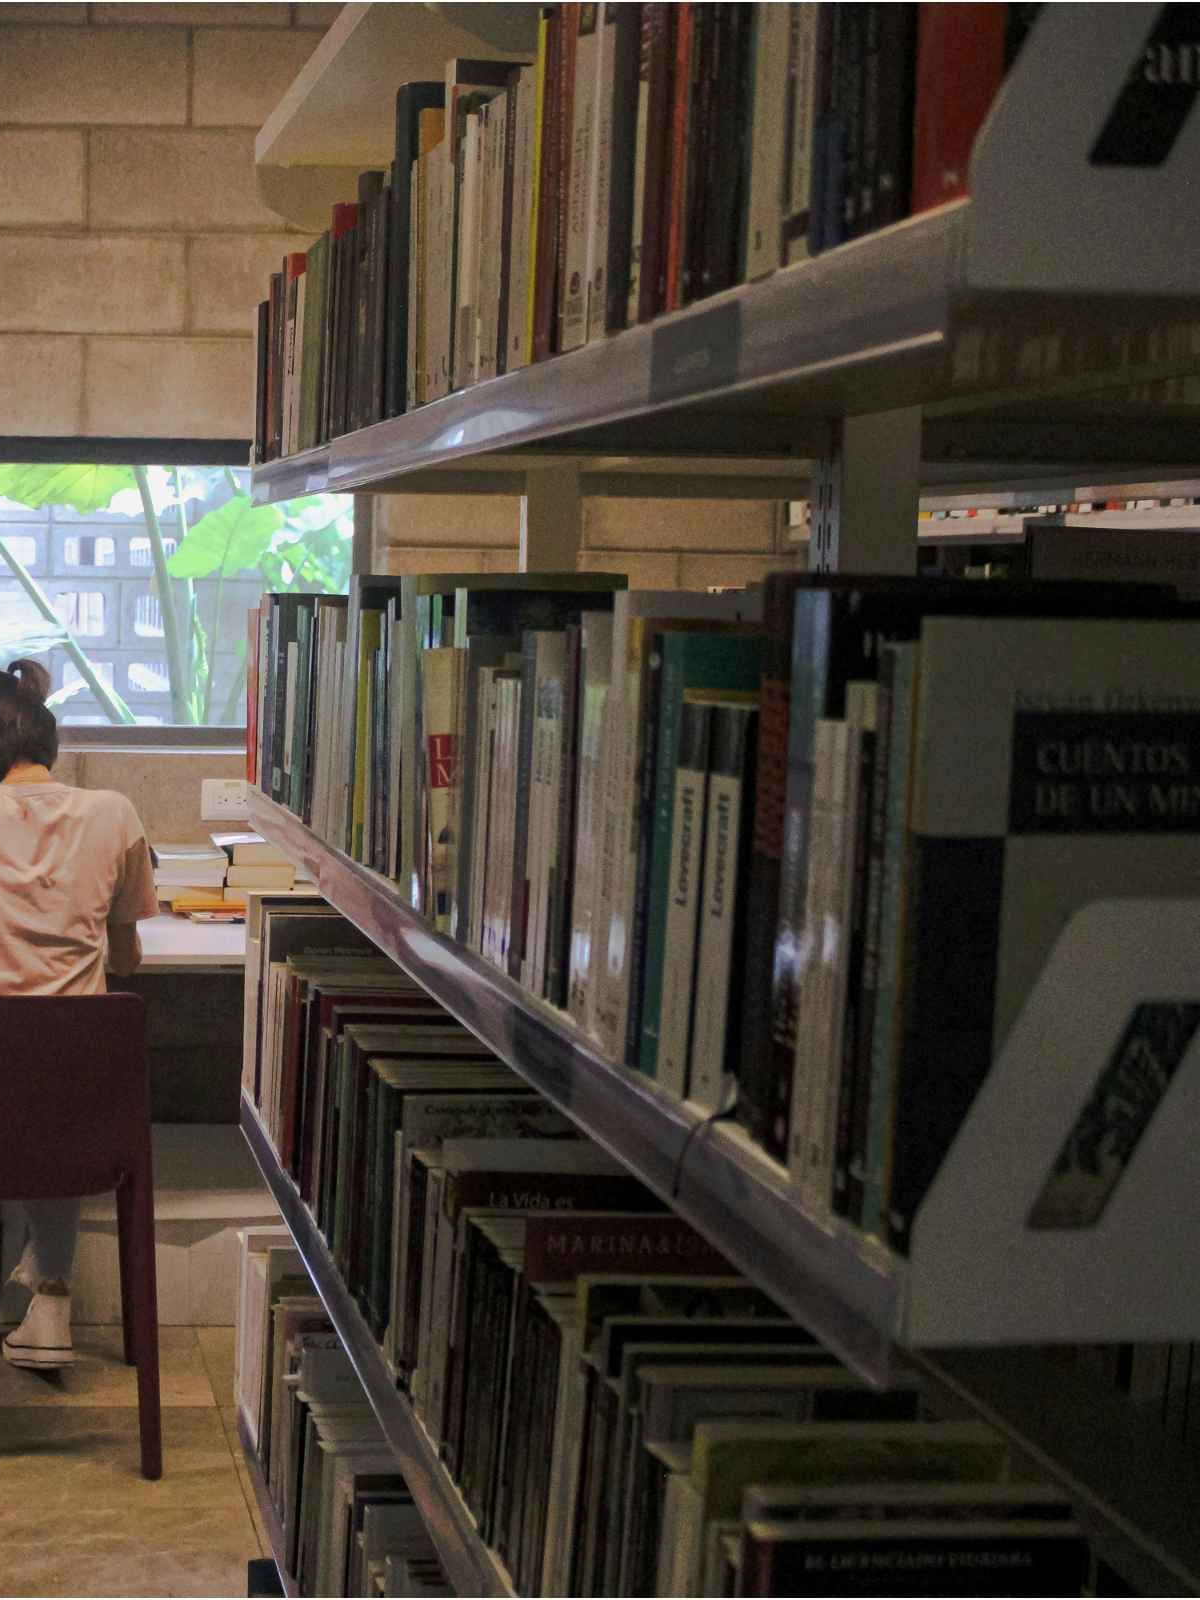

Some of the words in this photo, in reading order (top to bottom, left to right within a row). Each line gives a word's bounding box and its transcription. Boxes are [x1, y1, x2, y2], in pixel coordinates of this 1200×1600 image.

[1036, 738, 1192, 776] CUENTOS
[1035, 783, 1073, 815] DE
[1088, 783, 1138, 816] UN
[674, 784, 695, 907] Lovecraft
[710, 792, 731, 919] Lovecraft
[489, 1192, 509, 1209] La
[512, 1191, 551, 1209] Vida
[554, 1196, 576, 1209] es
